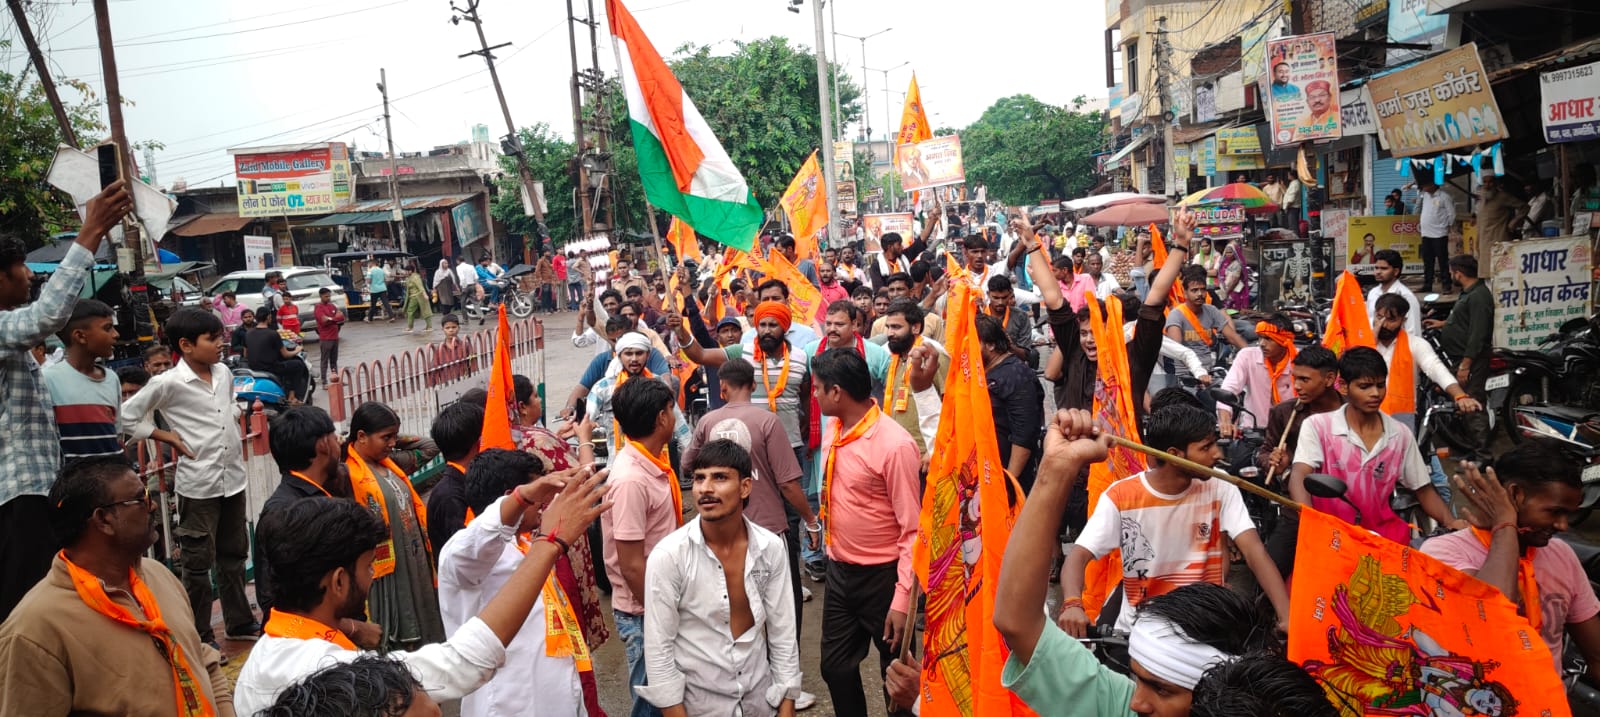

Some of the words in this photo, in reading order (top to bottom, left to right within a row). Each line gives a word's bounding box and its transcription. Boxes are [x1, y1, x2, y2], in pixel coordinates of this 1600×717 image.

[1376, 90, 1403, 118] शर्मा
[1402, 88, 1433, 117] जूस
[1549, 97, 1595, 121] आधार
[260, 160, 291, 172] Mobile
[292, 158, 326, 171] Gallery
[1195, 209, 1236, 220] FALUDA
[1521, 248, 1568, 274] आधार
[1312, 596, 1327, 622] राम
